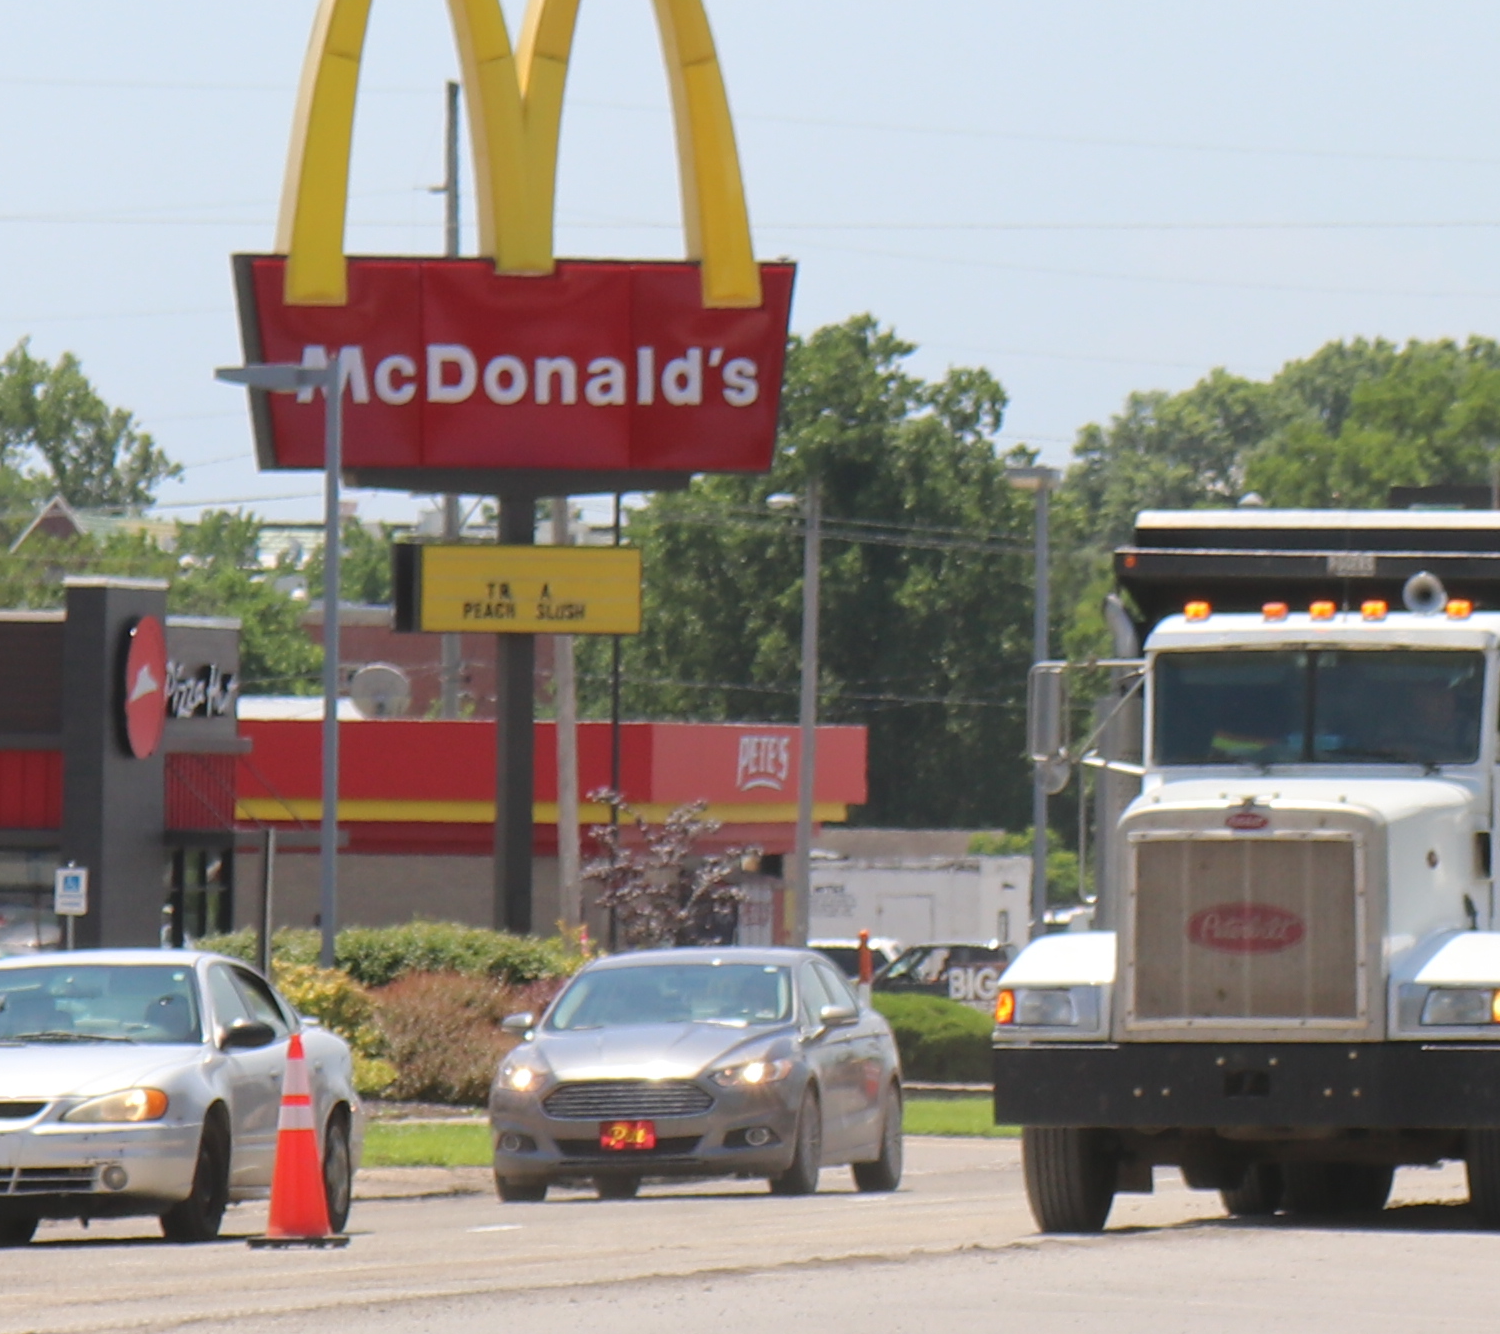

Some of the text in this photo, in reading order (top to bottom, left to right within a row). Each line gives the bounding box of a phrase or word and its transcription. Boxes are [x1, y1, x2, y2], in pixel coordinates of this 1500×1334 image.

[297, 343, 759, 406] McDonald's
[463, 602, 586, 620] PEACH SLUSH
